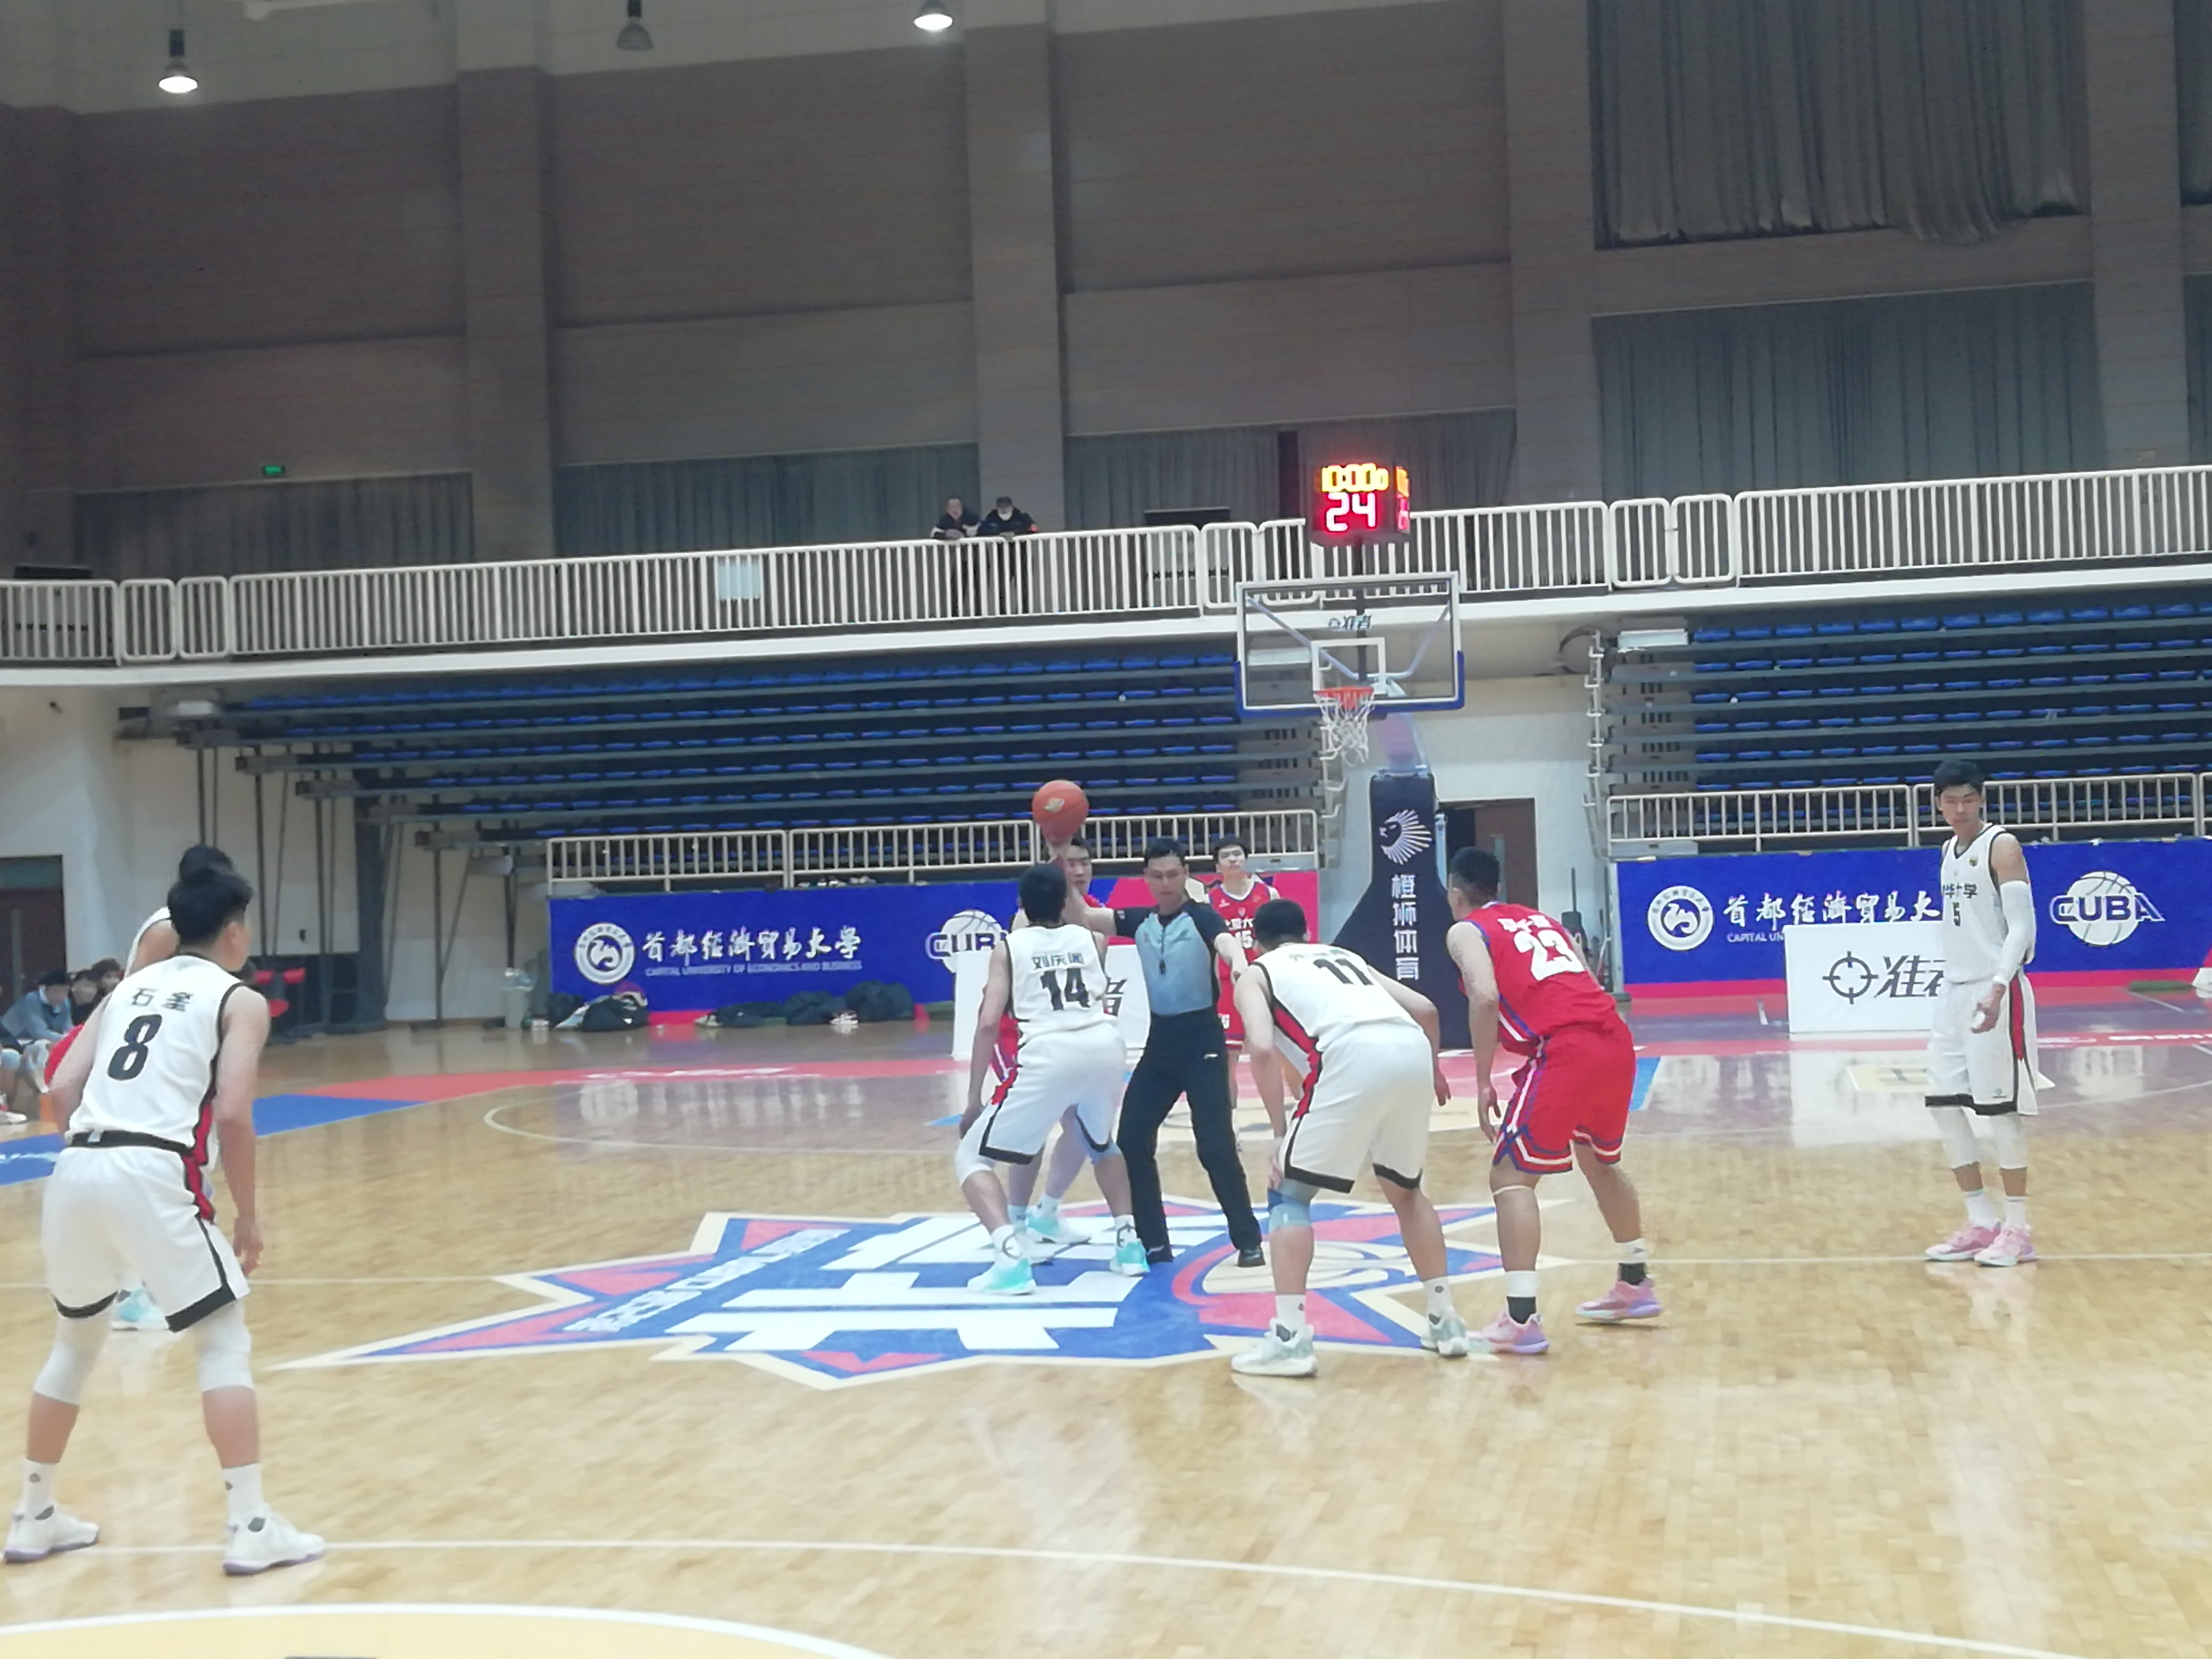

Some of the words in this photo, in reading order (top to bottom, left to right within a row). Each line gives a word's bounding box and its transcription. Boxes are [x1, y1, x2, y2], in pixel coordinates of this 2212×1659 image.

[1326, 492, 1376, 532] 24
[1391, 875, 1420, 980] 橙狮体育
[2050, 892, 2166, 925] CUBA
[926, 931, 1007, 959] CUB
[1513, 929, 1586, 981] 23
[1040, 968, 1090, 1011] 14
[1312, 958, 1375, 986] 11
[106, 1013, 162, 1081] 8
